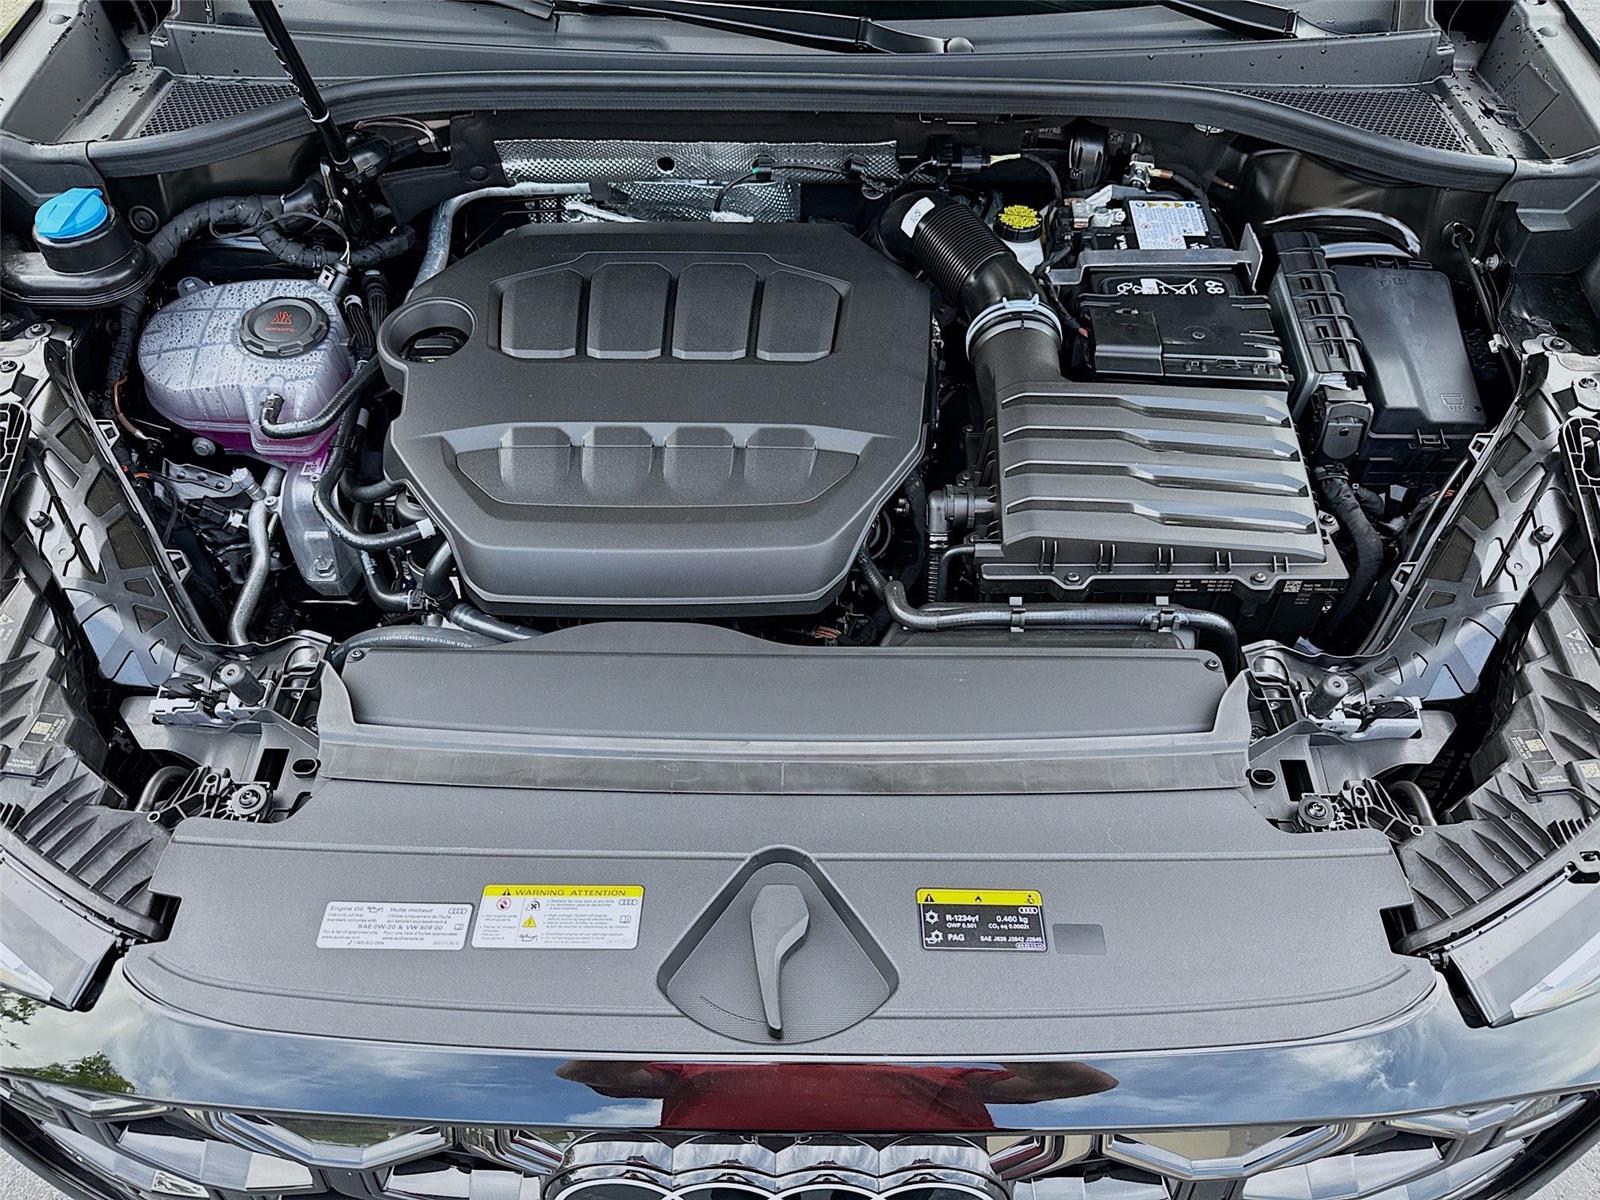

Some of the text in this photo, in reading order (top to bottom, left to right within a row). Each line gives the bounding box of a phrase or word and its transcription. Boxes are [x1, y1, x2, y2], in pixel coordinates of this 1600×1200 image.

[515, 889, 626, 897] WARNING ATTENTION
[945, 914, 979, 923] R-1234yf
[1018, 915, 1029, 924] kg
[947, 933, 965, 942] PAG
